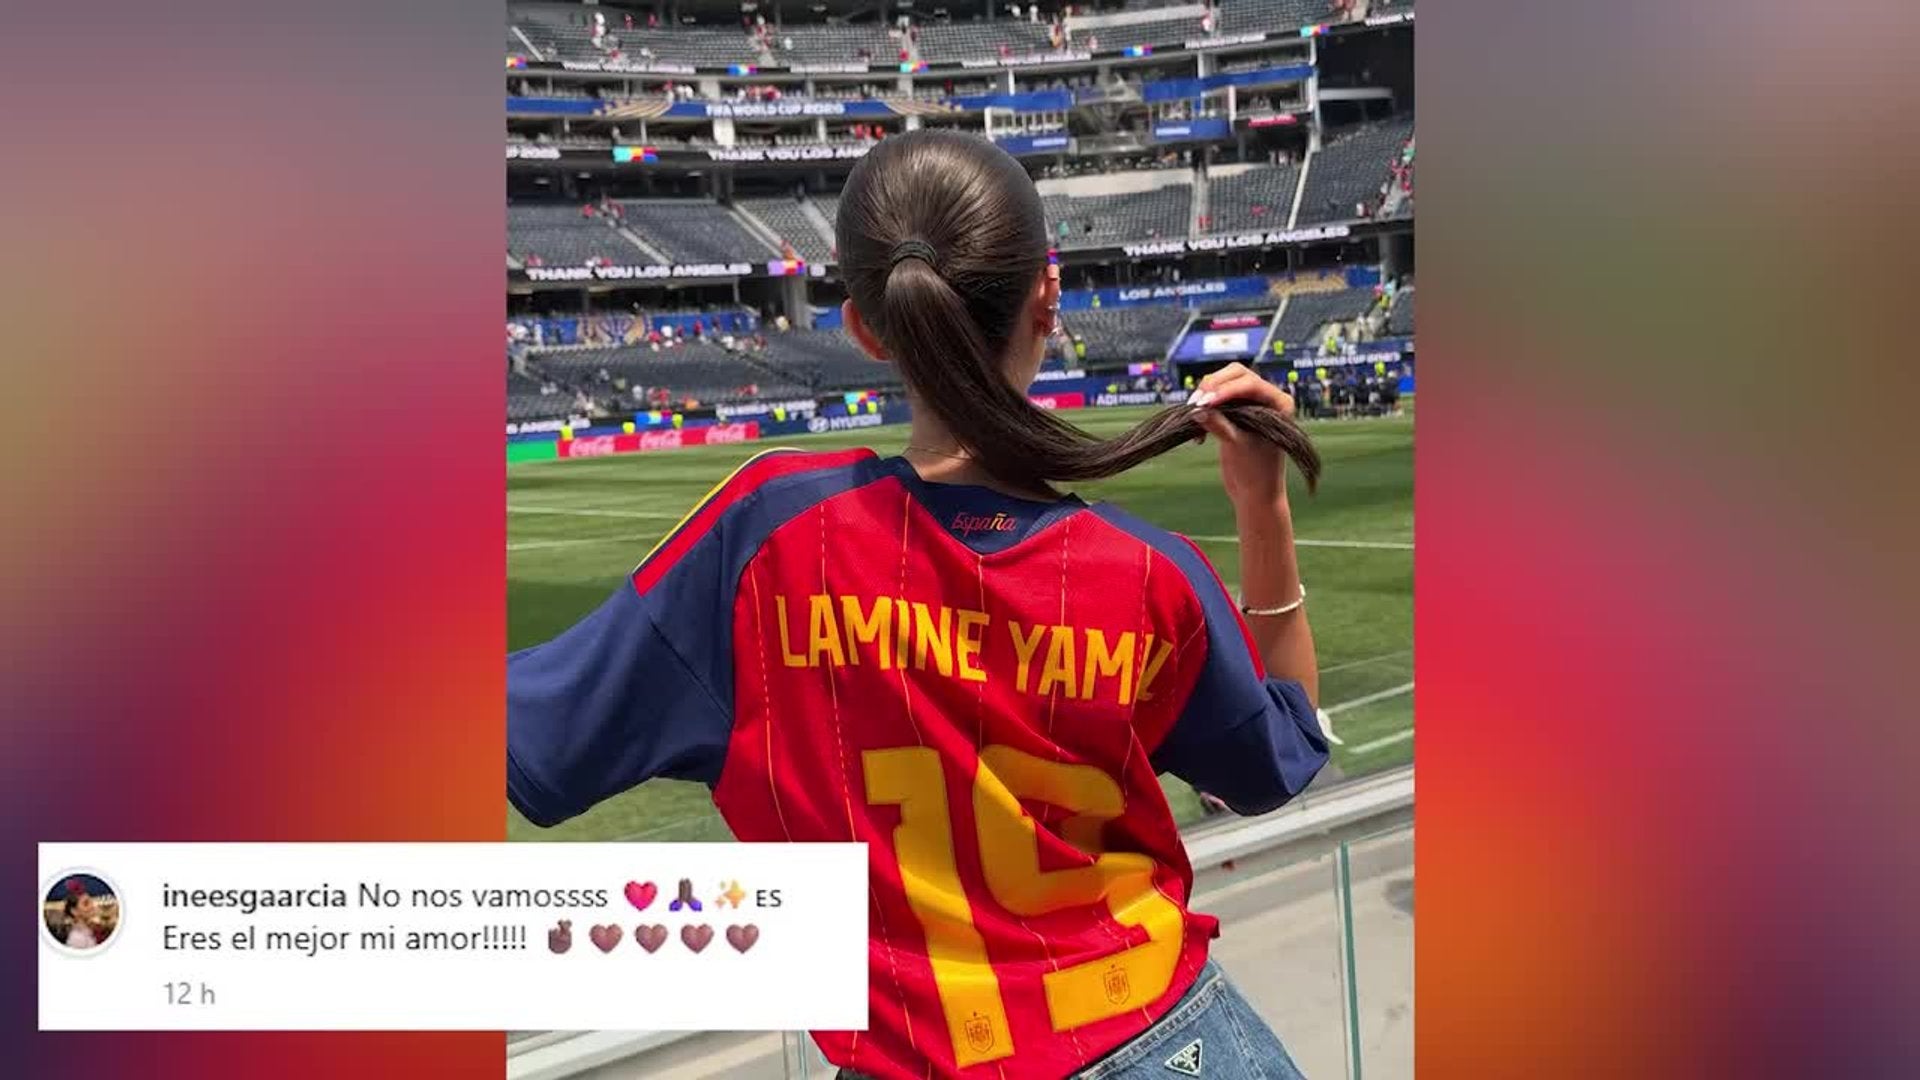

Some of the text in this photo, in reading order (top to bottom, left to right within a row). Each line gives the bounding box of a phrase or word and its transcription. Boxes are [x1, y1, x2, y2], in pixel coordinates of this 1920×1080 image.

[708, 148, 764, 161] THANK
[766, 147, 800, 160] YOU
[802, 147, 835, 160] LOS
[1123, 226, 1350, 257] THANK YOU LOS ANGELES
[525, 263, 752, 281] THANK YOU LOS ANGELES
[1119, 282, 1227, 301] LOS ANGELES
[951, 512, 1017, 537] España
[775, 594, 990, 682] LAMINE
[861, 744, 1185, 1069] 19
